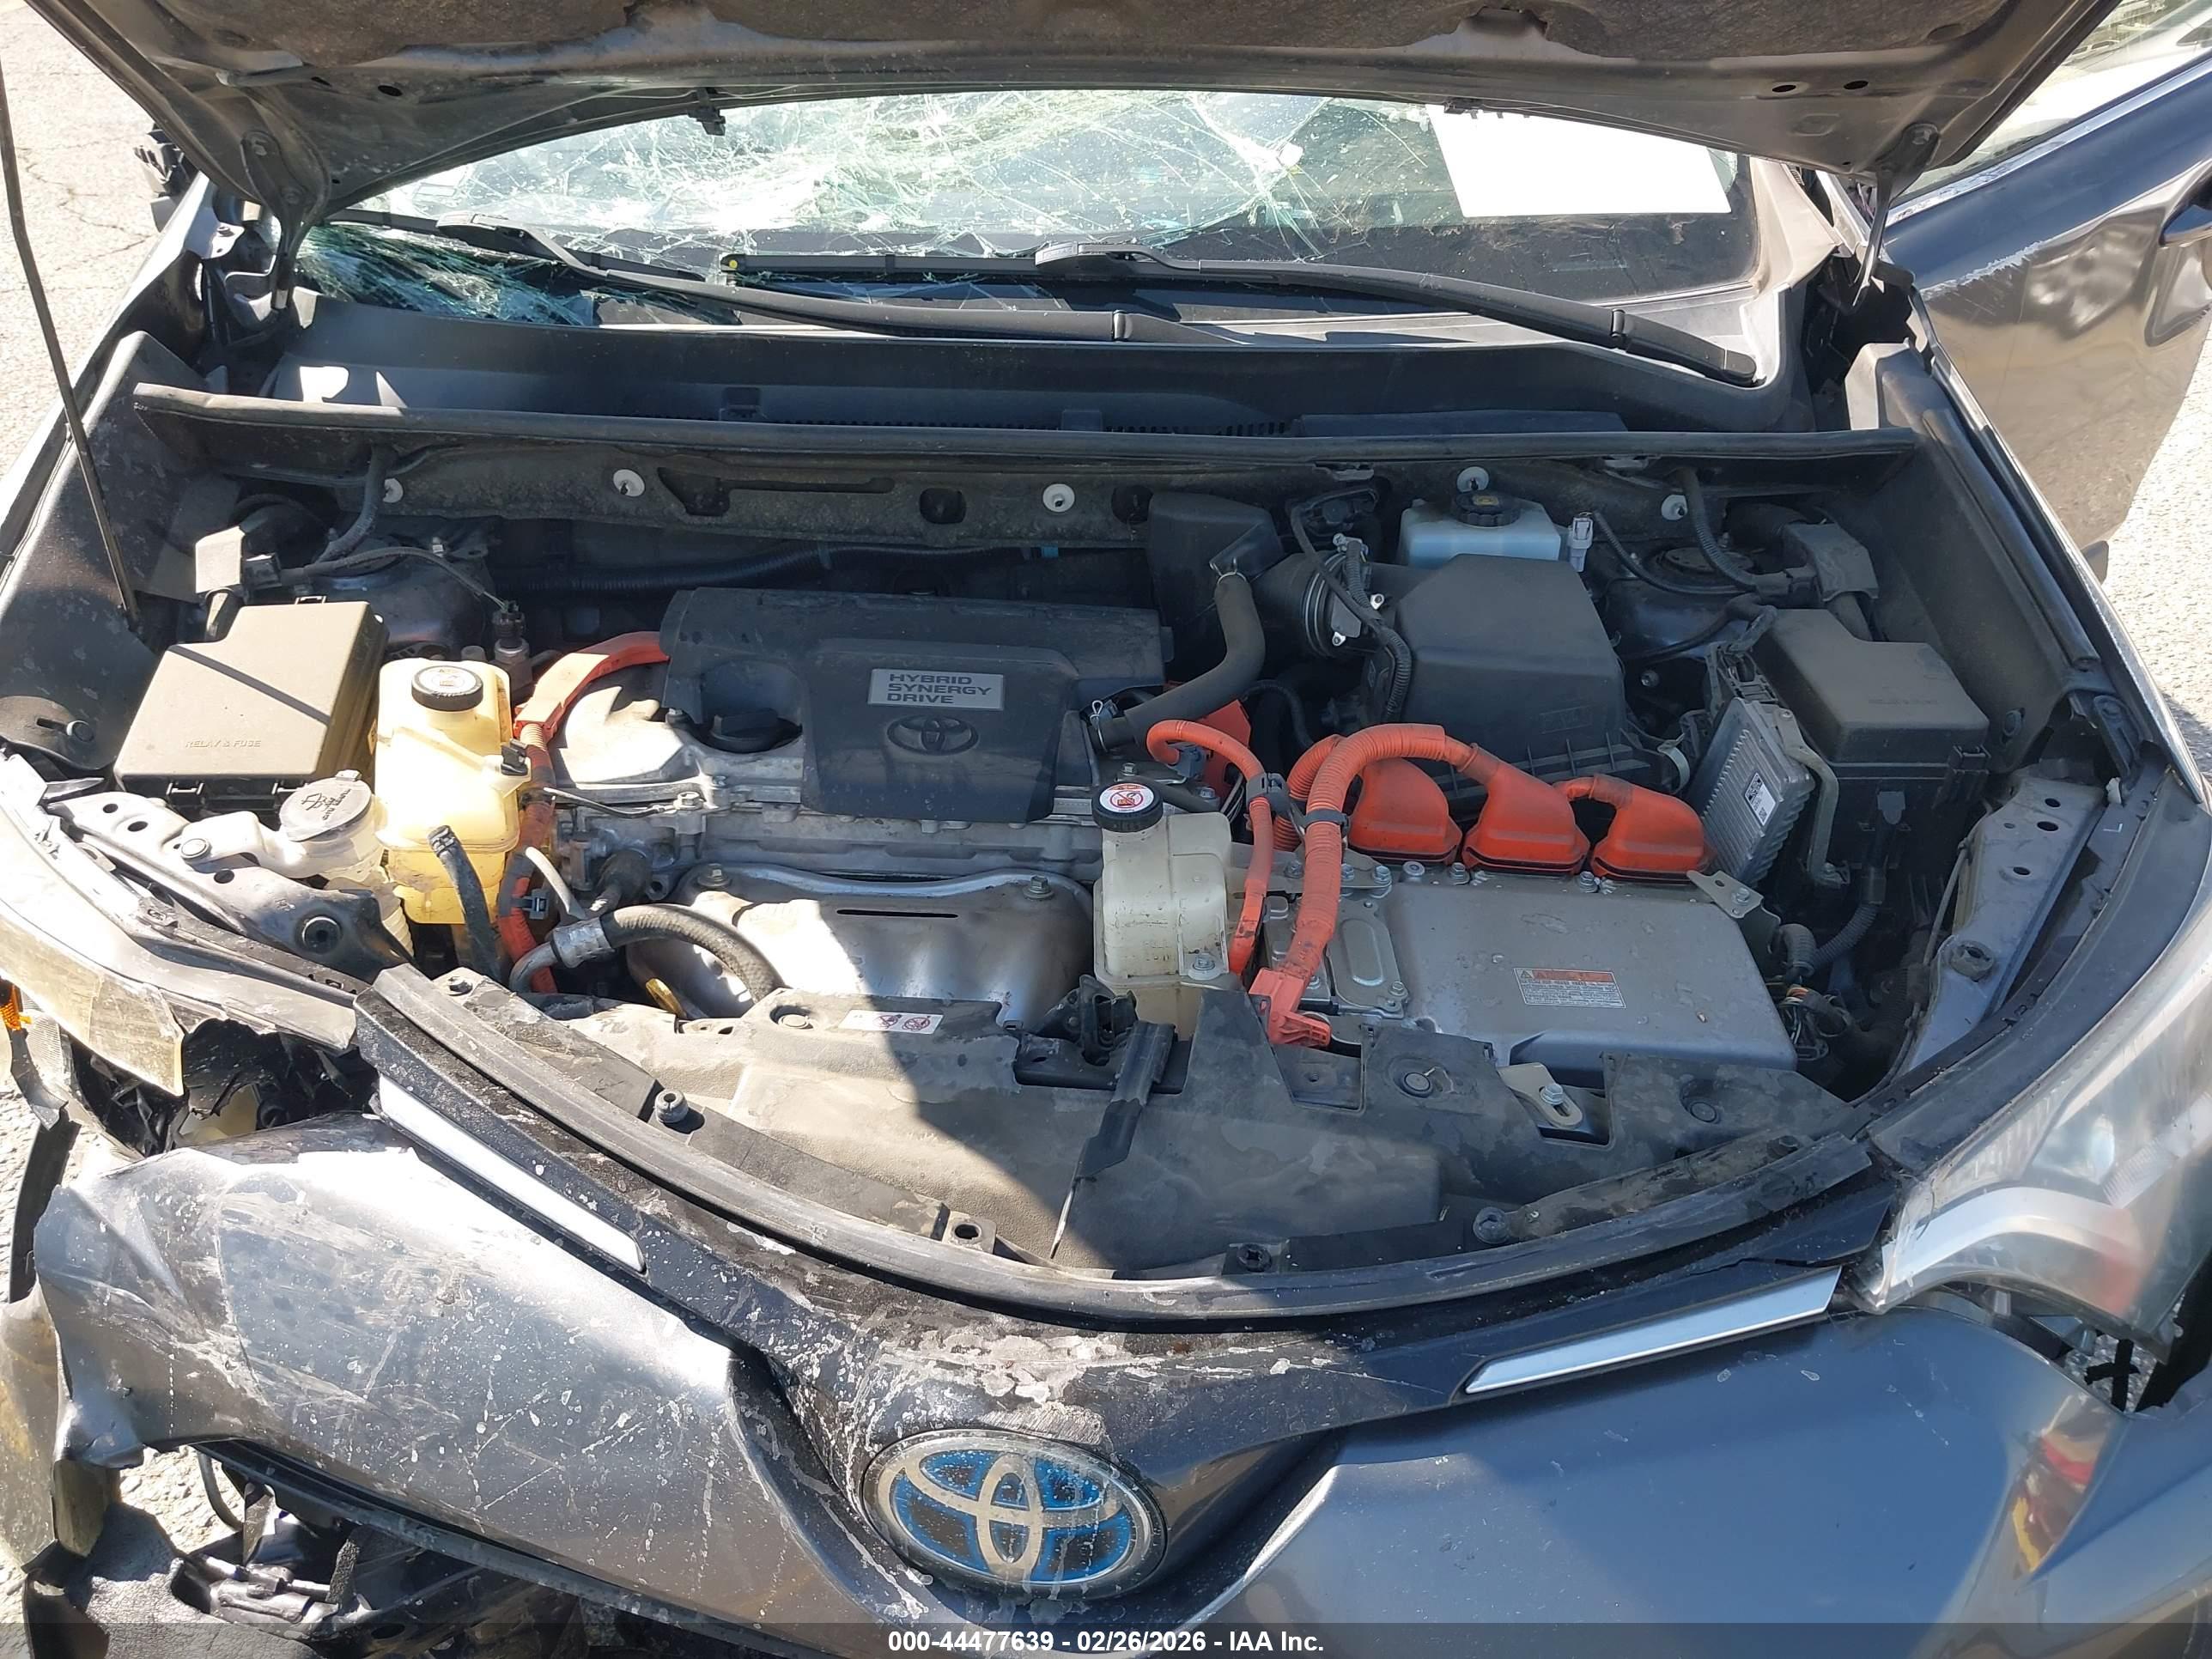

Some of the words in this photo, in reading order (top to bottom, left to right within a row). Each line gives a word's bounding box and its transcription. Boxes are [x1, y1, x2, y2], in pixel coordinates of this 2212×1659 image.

[890, 674, 972, 684] HYBRID
[888, 684, 992, 695] SYNERGY
[886, 693, 954, 704] DRIVE
